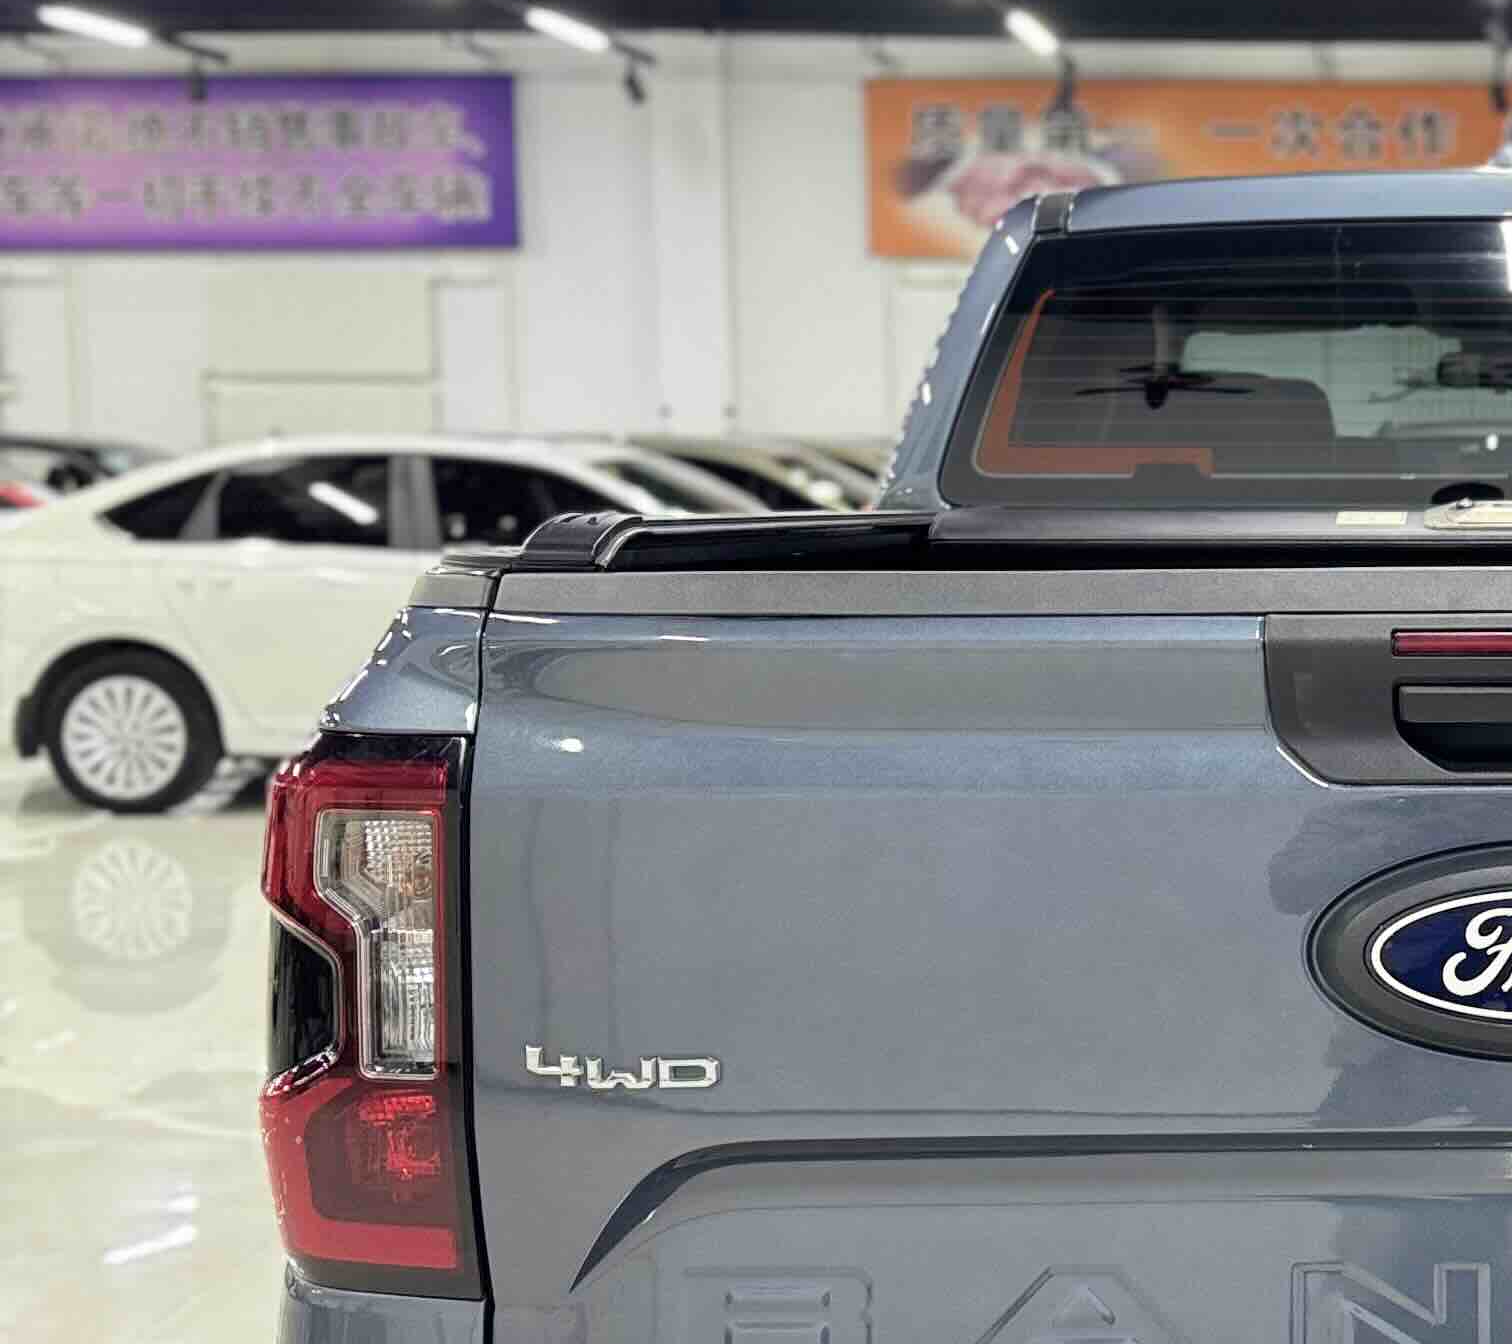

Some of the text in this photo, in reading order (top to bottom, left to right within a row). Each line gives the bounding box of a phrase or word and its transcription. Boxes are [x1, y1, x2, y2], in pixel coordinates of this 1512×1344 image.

[1208, 106, 1455, 159] 一次合作
[524, 1043, 721, 1089] 4WD
